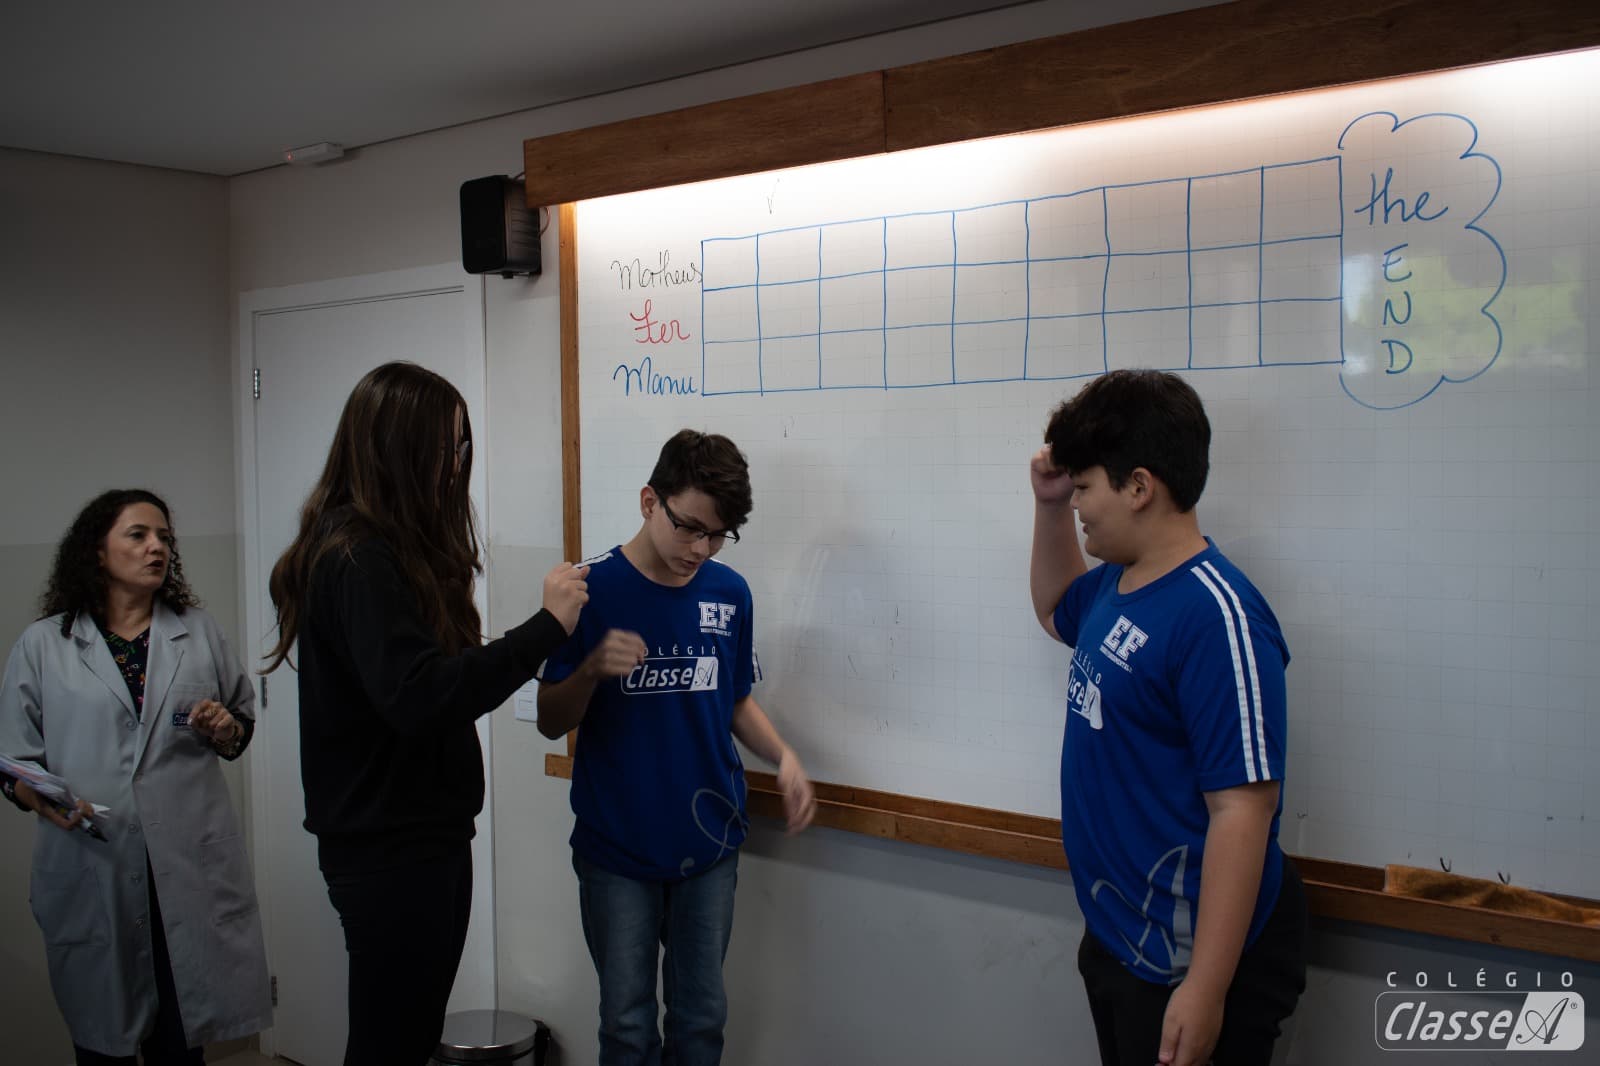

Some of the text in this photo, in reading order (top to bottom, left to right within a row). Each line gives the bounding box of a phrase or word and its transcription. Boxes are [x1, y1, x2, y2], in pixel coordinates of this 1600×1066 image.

[1353, 166, 1449, 226] the
[613, 356, 698, 397] Manu
[698, 601, 737, 630] EF
[1103, 614, 1149, 661] EF
[626, 664, 694, 689] Classe
